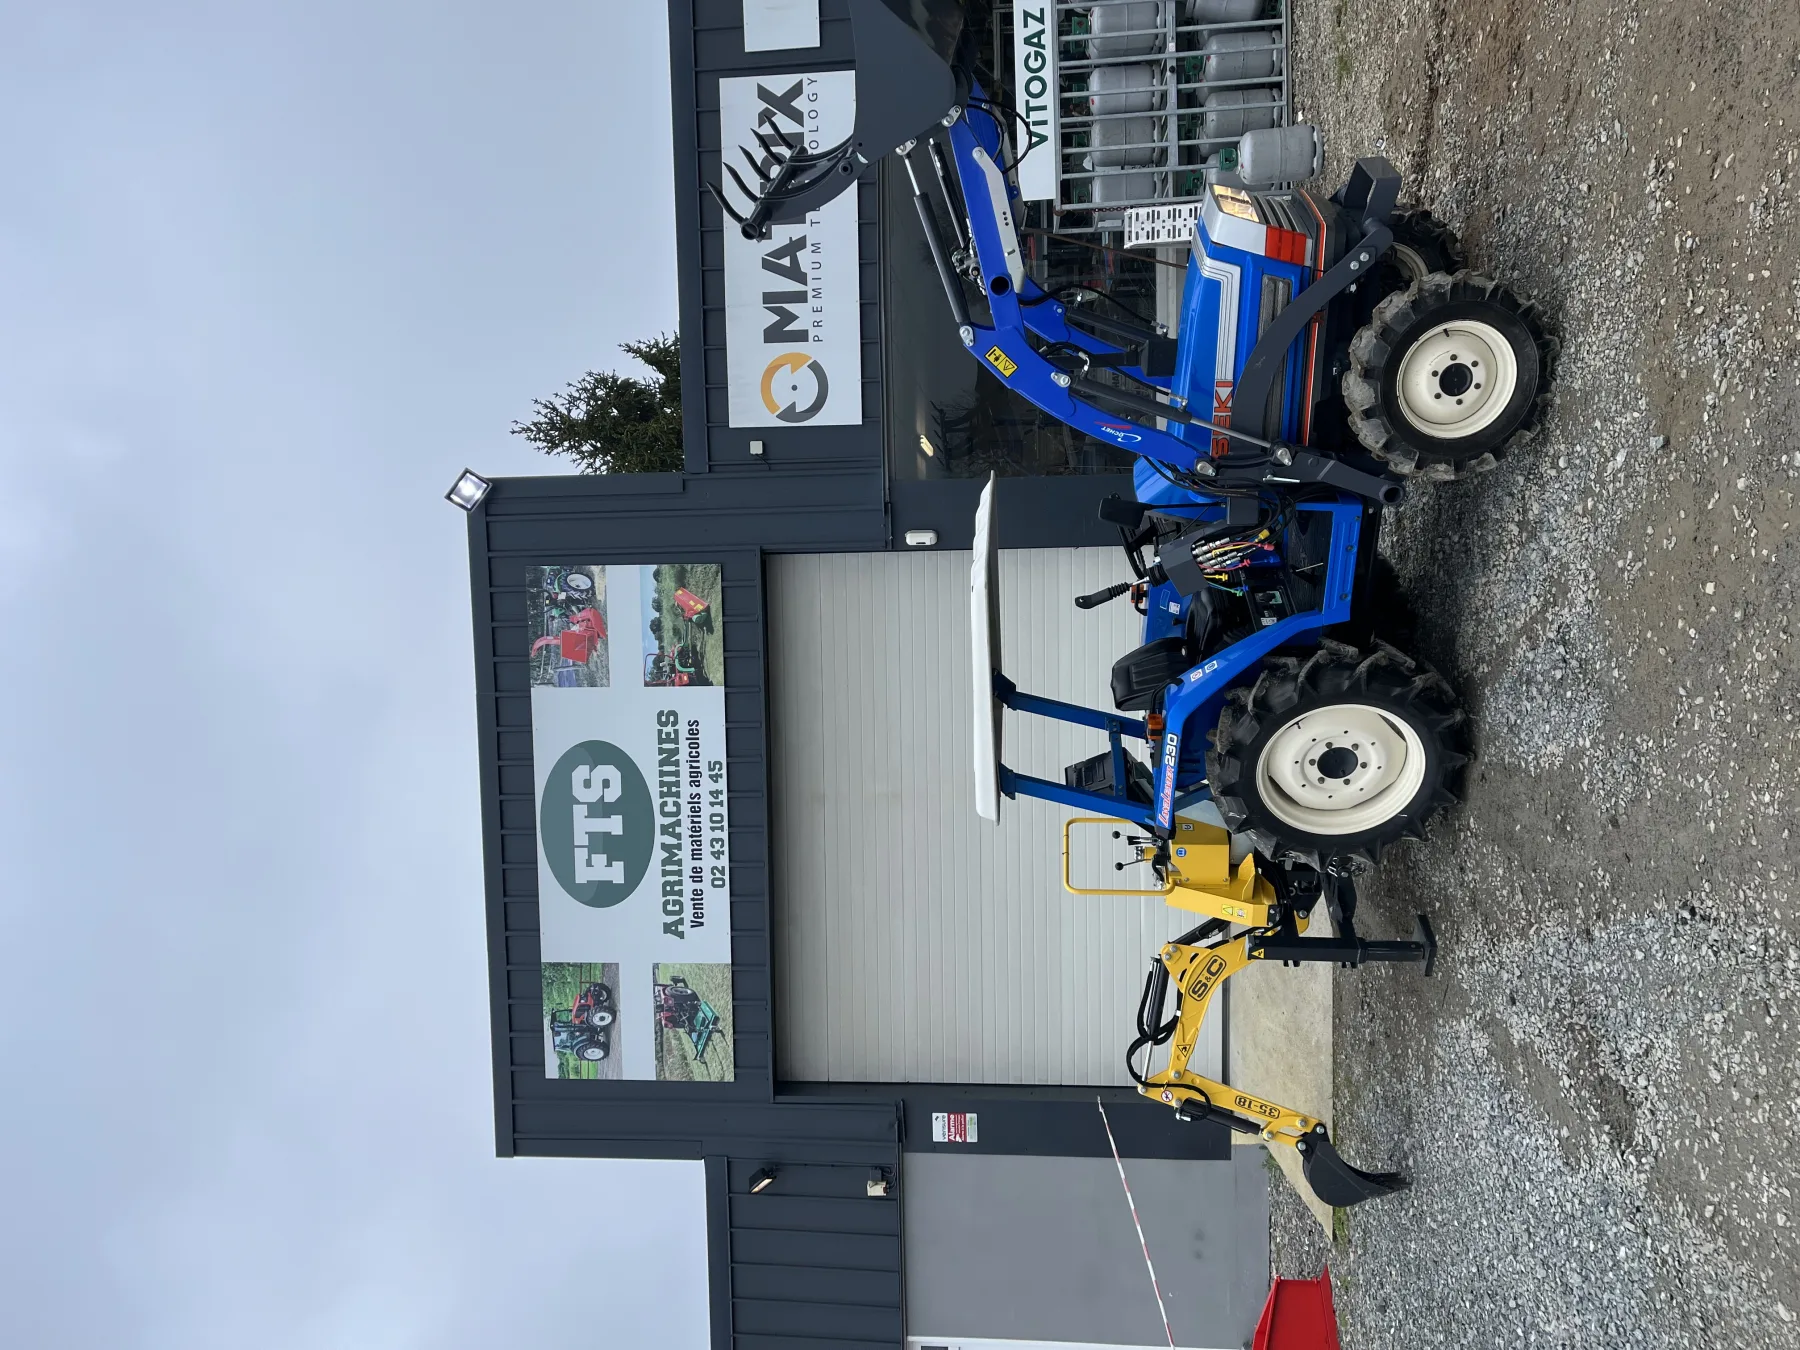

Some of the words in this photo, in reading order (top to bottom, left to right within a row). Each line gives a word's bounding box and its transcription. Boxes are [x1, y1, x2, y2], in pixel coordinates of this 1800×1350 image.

[807, 77, 821, 227] TOLOGY
[810, 242, 823, 342] PREMIUM
[1211, 381, 1233, 456] SEKI
[685, 720, 702, 788] agricoles
[1165, 734, 1178, 766] 230
[708, 760, 723, 783] 45
[708, 789, 723, 808] 14
[572, 764, 624, 884] FTS
[657, 710, 684, 940] AGRIMACHINES
[686, 792, 702, 861] matériels
[709, 813, 724, 832] 10
[710, 838, 724, 860] 43
[688, 866, 703, 884] de
[710, 866, 726, 888] 02
[689, 888, 704, 928] Vente
[1192, 958, 1224, 998] S&C
[1238, 1098, 1278, 1116] 35-18
